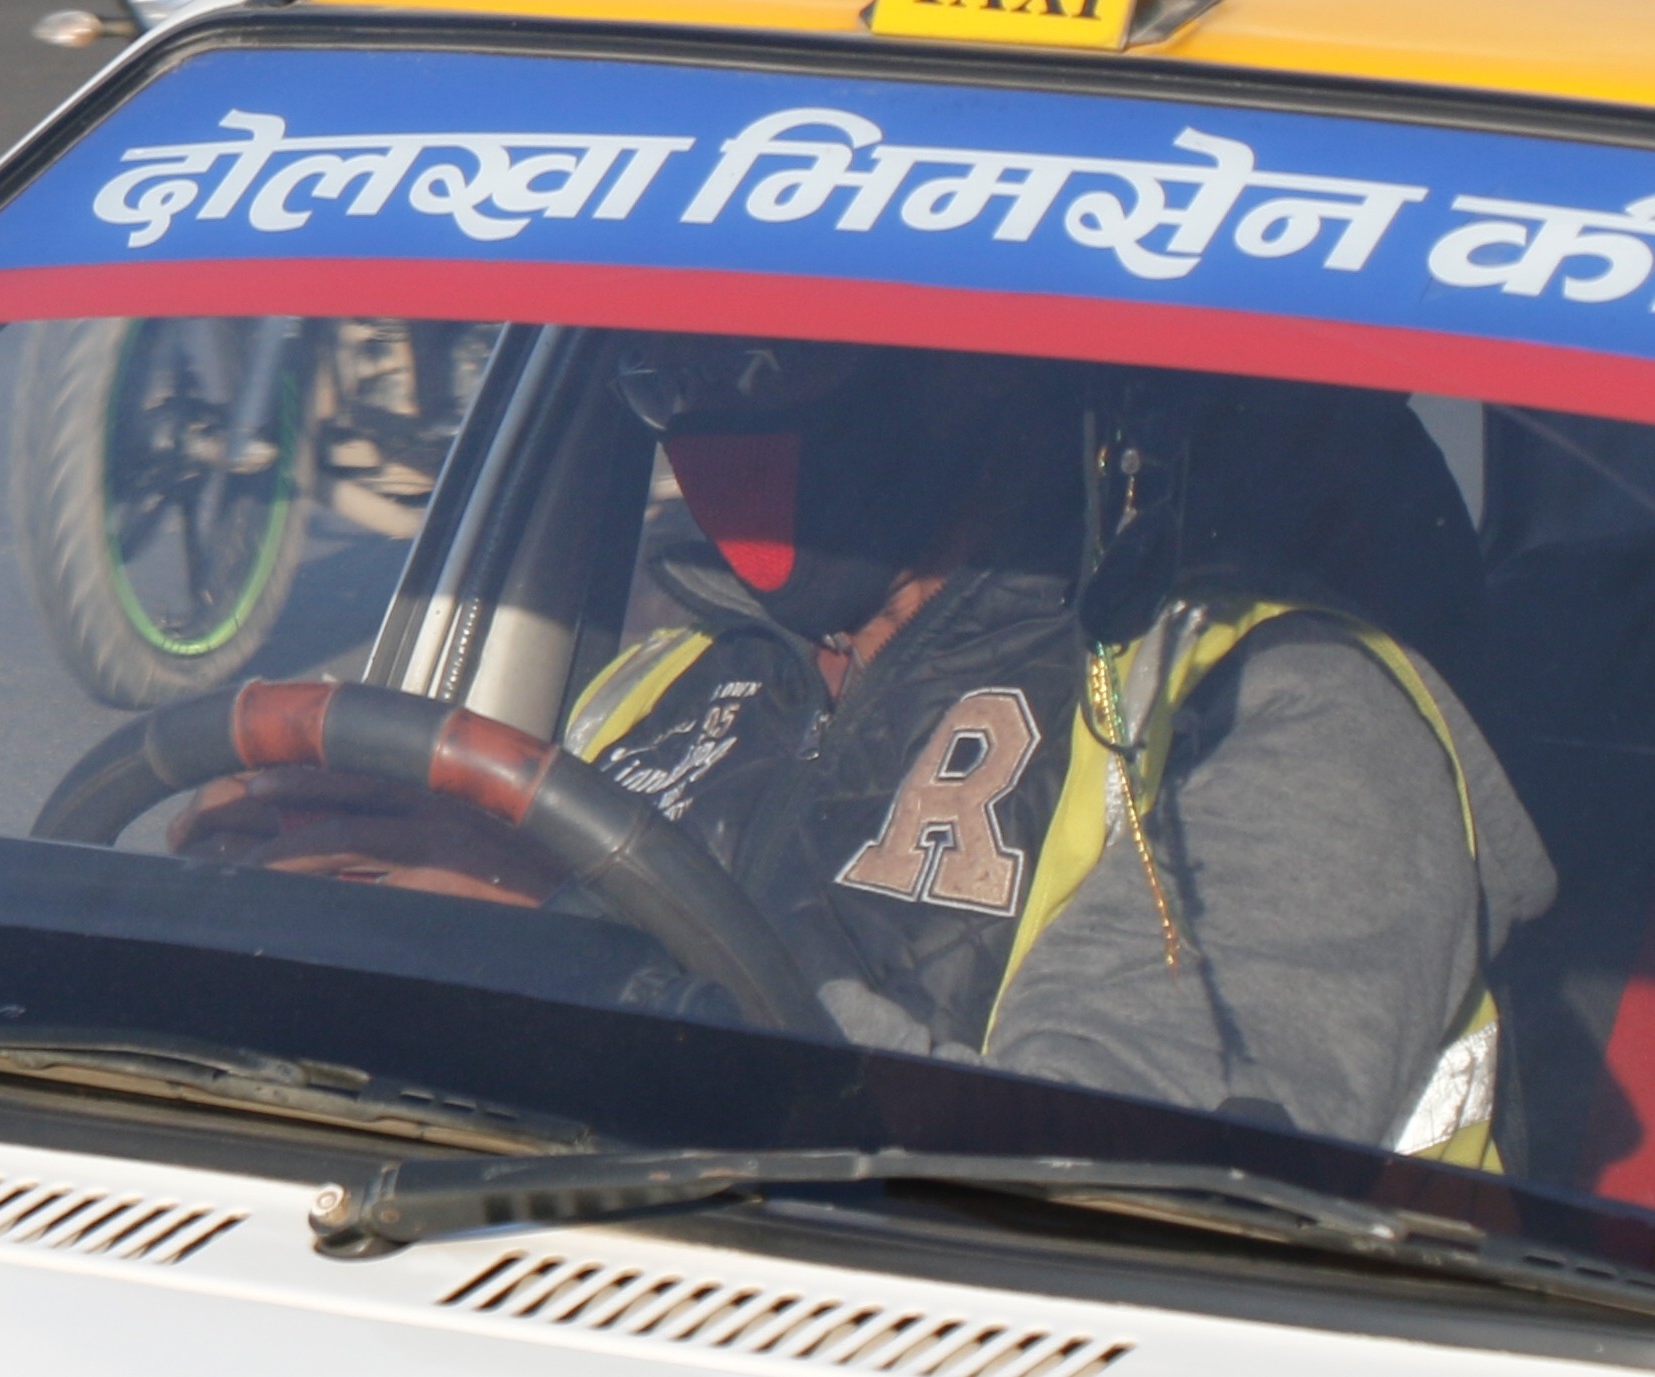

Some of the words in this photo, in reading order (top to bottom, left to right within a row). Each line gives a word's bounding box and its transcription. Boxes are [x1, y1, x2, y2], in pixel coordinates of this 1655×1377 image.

[92, 109, 695, 248] दोलखा
[680, 107, 1428, 280] भिमसेन
[834, 686, 1042, 917] R
